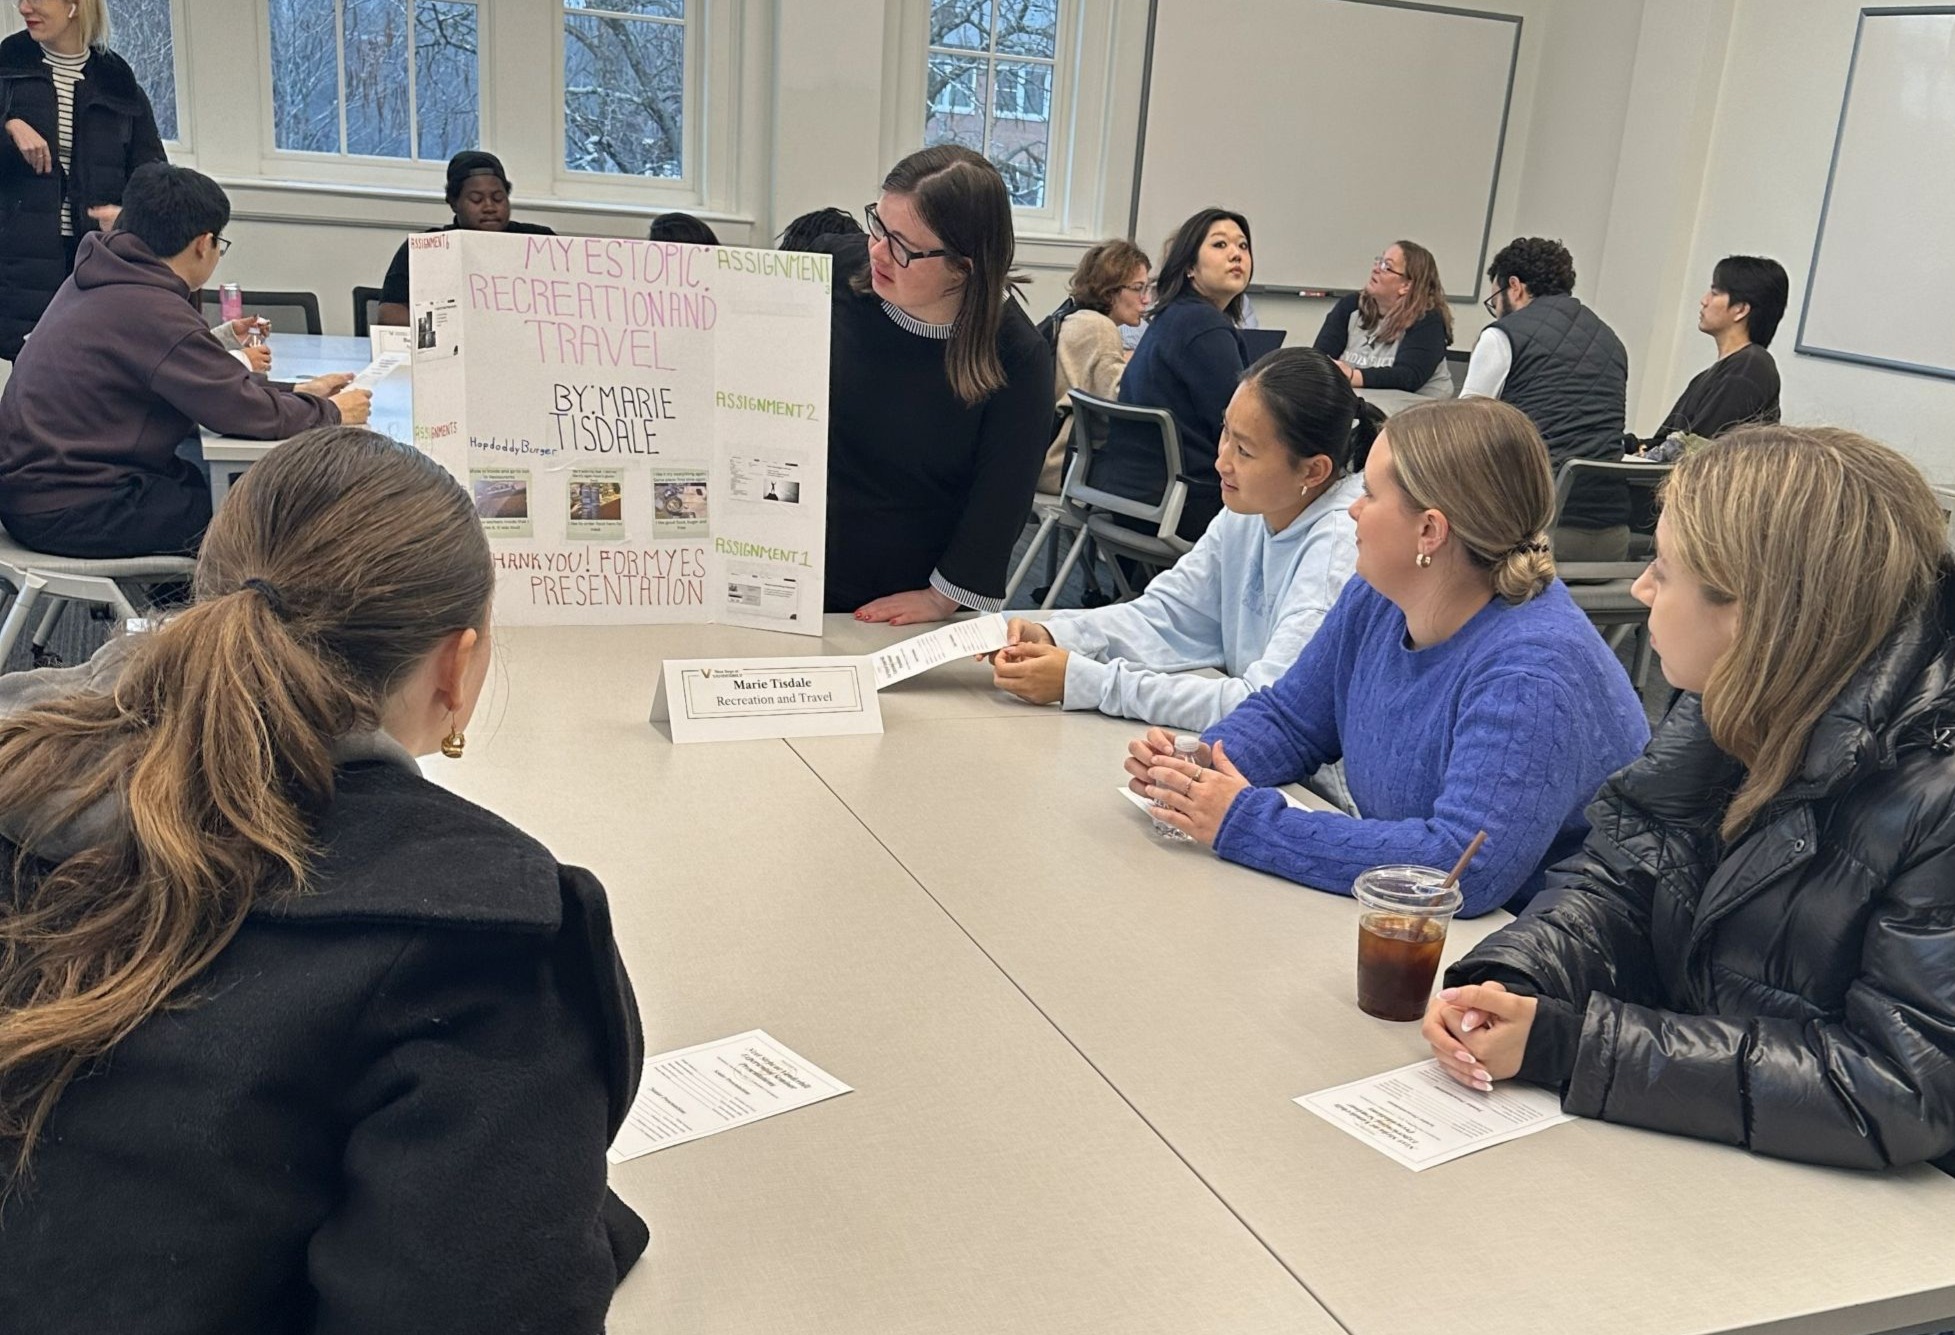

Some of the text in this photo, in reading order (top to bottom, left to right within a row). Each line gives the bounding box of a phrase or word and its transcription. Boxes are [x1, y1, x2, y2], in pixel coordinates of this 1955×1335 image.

[525, 236, 574, 272] MY
[717, 249, 831, 282] ASSIGNMENT
[524, 319, 677, 371] TRAVEL
[600, 386, 676, 419] MARIE
[716, 391, 819, 422] ASSIGNMENT 2
[549, 412, 660, 455] TISDALE
[492, 552, 542, 571] HANK
[715, 537, 813, 568] ASSIGNMENT 1
[530, 574, 703, 606] PRESENTATION
[716, 692, 833, 706] Recreation and Travel
[733, 678, 812, 690] Marie Tisdale
